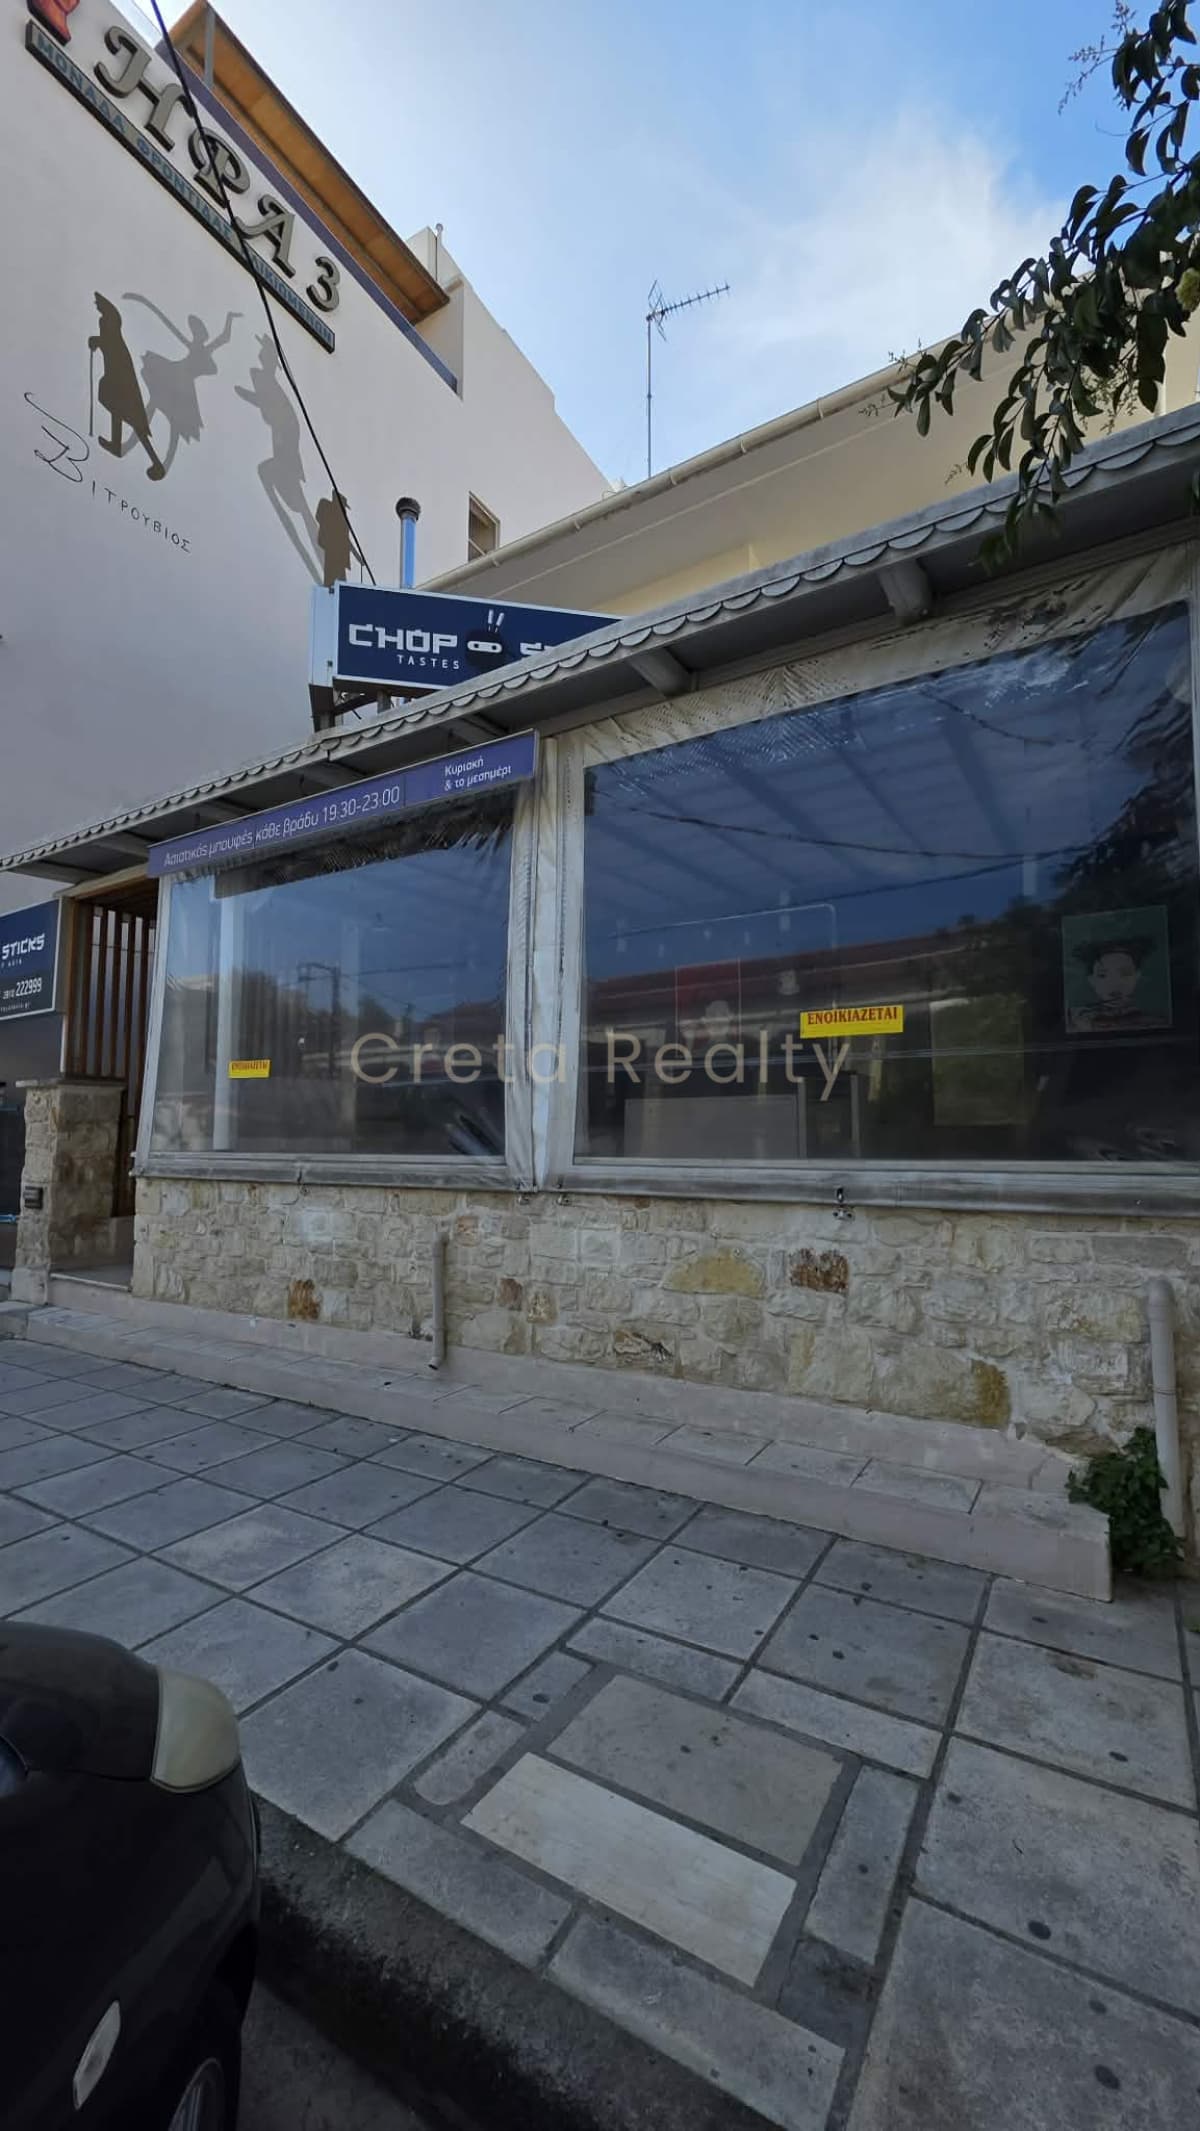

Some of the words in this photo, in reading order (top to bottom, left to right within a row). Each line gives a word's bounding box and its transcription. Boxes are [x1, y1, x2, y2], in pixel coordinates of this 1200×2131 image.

[37, 33, 127, 135] ΜΟΝΑΔΑ
[136, 136, 234, 241] ΦΡΟΝΤΙΔΑΣ
[306, 256, 341, 312] 3
[24, 391, 192, 553] ΒΙΤΡΟΥΒΙΟΣ
[348, 623, 458, 654] CHOP
[397, 654, 460, 670] TASTES
[444, 755, 484, 777] Κυριακή
[444, 779, 452, 792] &
[455, 777, 465, 789] το
[466, 765, 512, 788] μεσημέρι
[255, 822, 281, 841] κάθε
[282, 810, 320, 839] βράδυ
[1, 933, 46, 960] STICKS
[16, 977, 43, 997] 222999
[807, 1006, 898, 1025] ΕΝΟΙΚΙΑΖΕΤΑΙ
